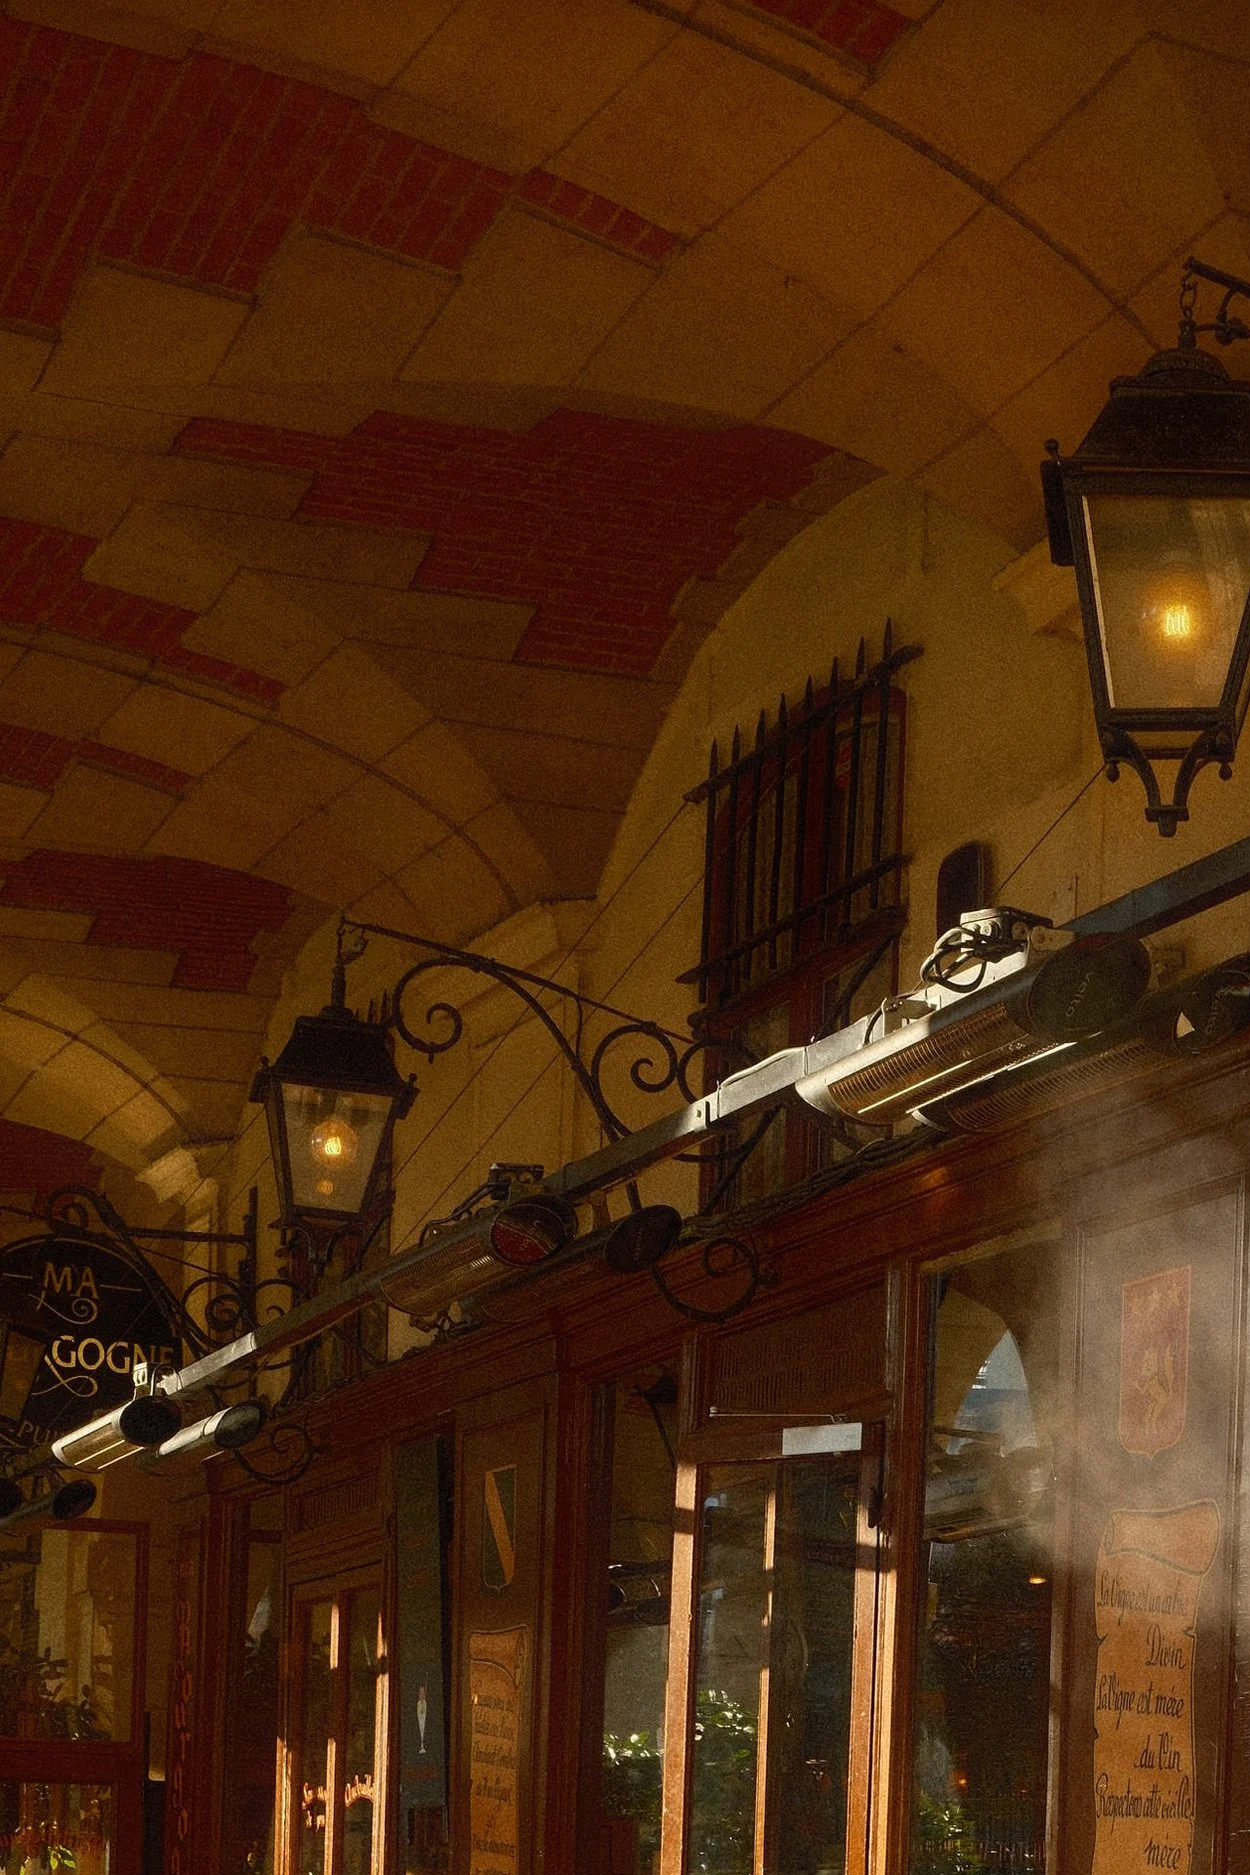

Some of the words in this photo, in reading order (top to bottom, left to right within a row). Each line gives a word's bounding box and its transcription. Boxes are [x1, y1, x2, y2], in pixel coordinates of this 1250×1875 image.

[42, 1262, 98, 1300] MA
[51, 1335, 174, 1374] GOGNE
[1145, 1624, 1185, 1670] Divin
[1107, 1671, 1136, 1731] Vigne
[1136, 1681, 1153, 1715] est
[1134, 1734, 1156, 1769] du
